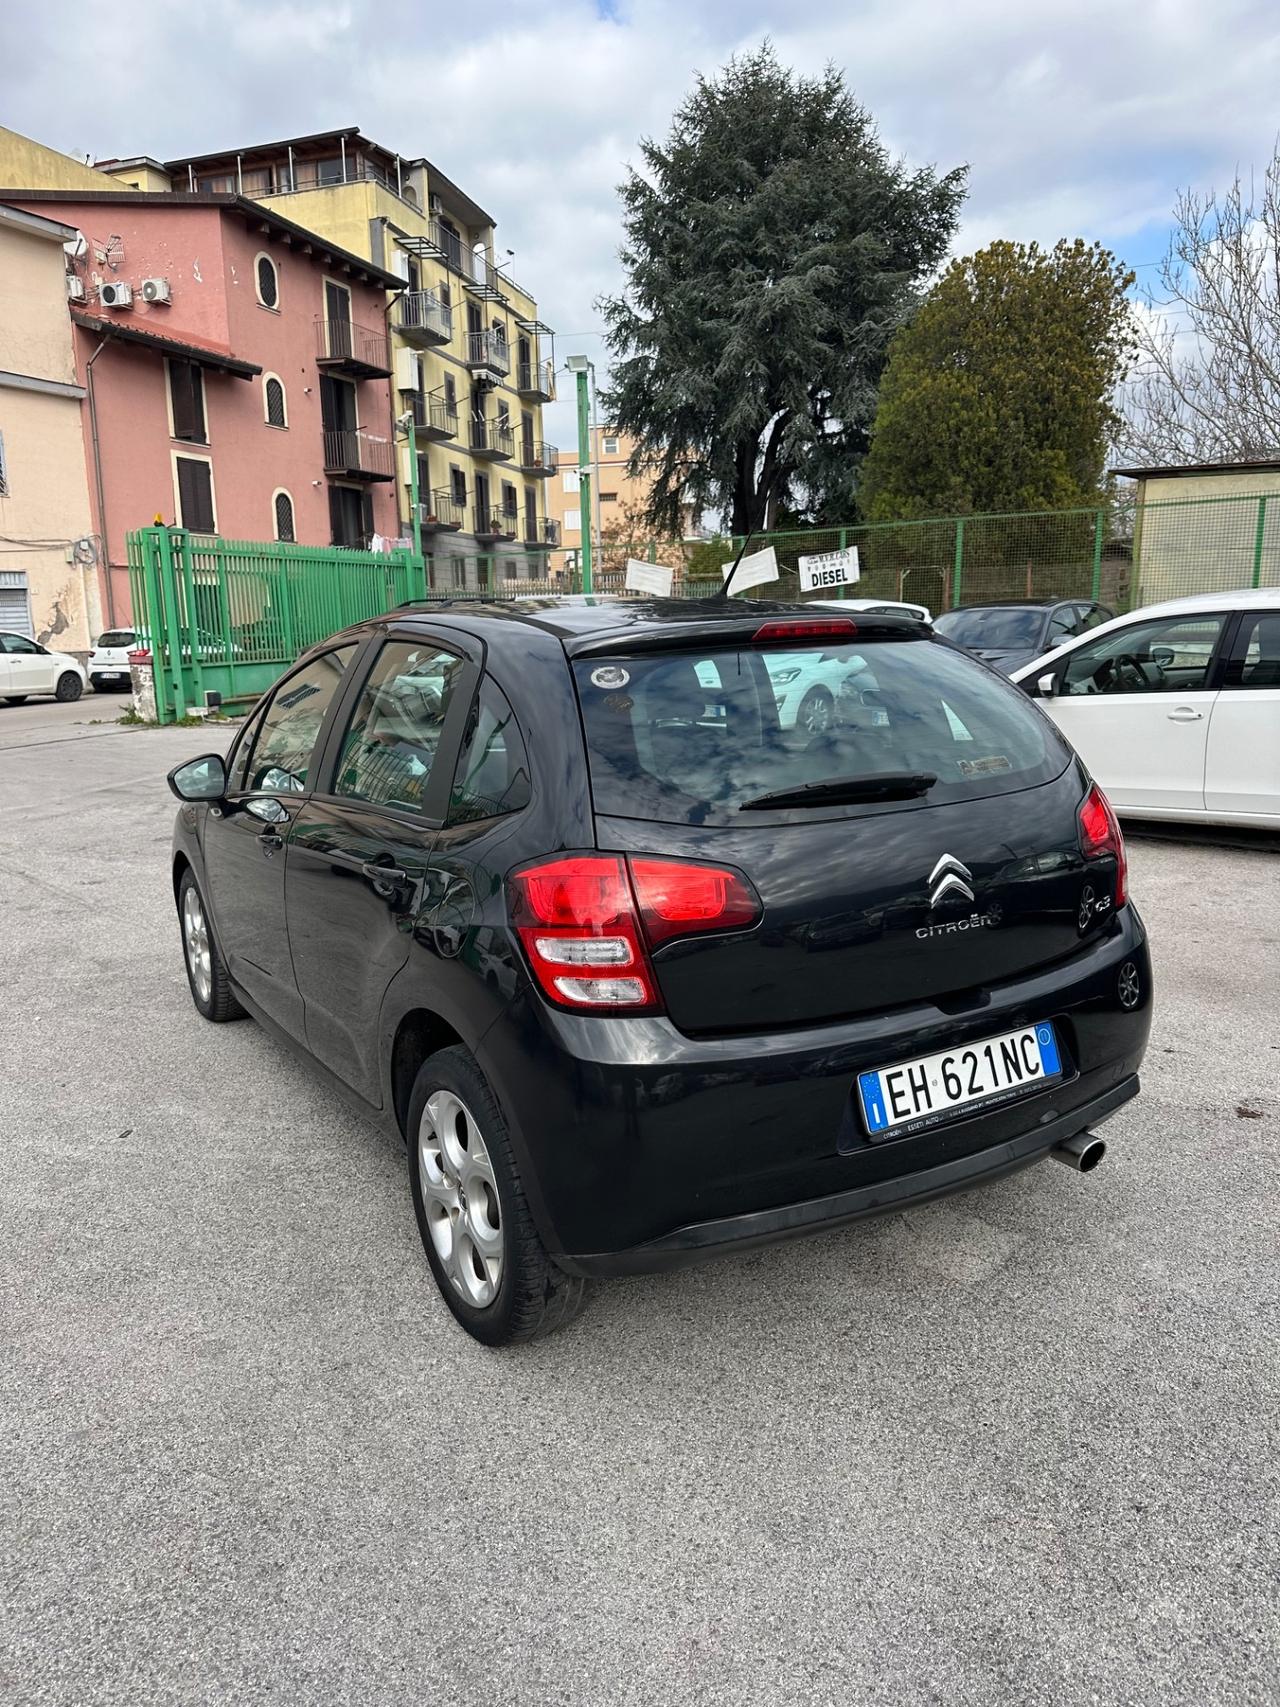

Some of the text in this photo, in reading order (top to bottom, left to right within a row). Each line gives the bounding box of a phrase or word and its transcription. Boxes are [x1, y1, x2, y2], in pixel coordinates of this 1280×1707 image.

[811, 568, 848, 587] DIESEL
[886, 1064, 933, 1119] EH
[941, 1034, 1040, 1101] 621NC
